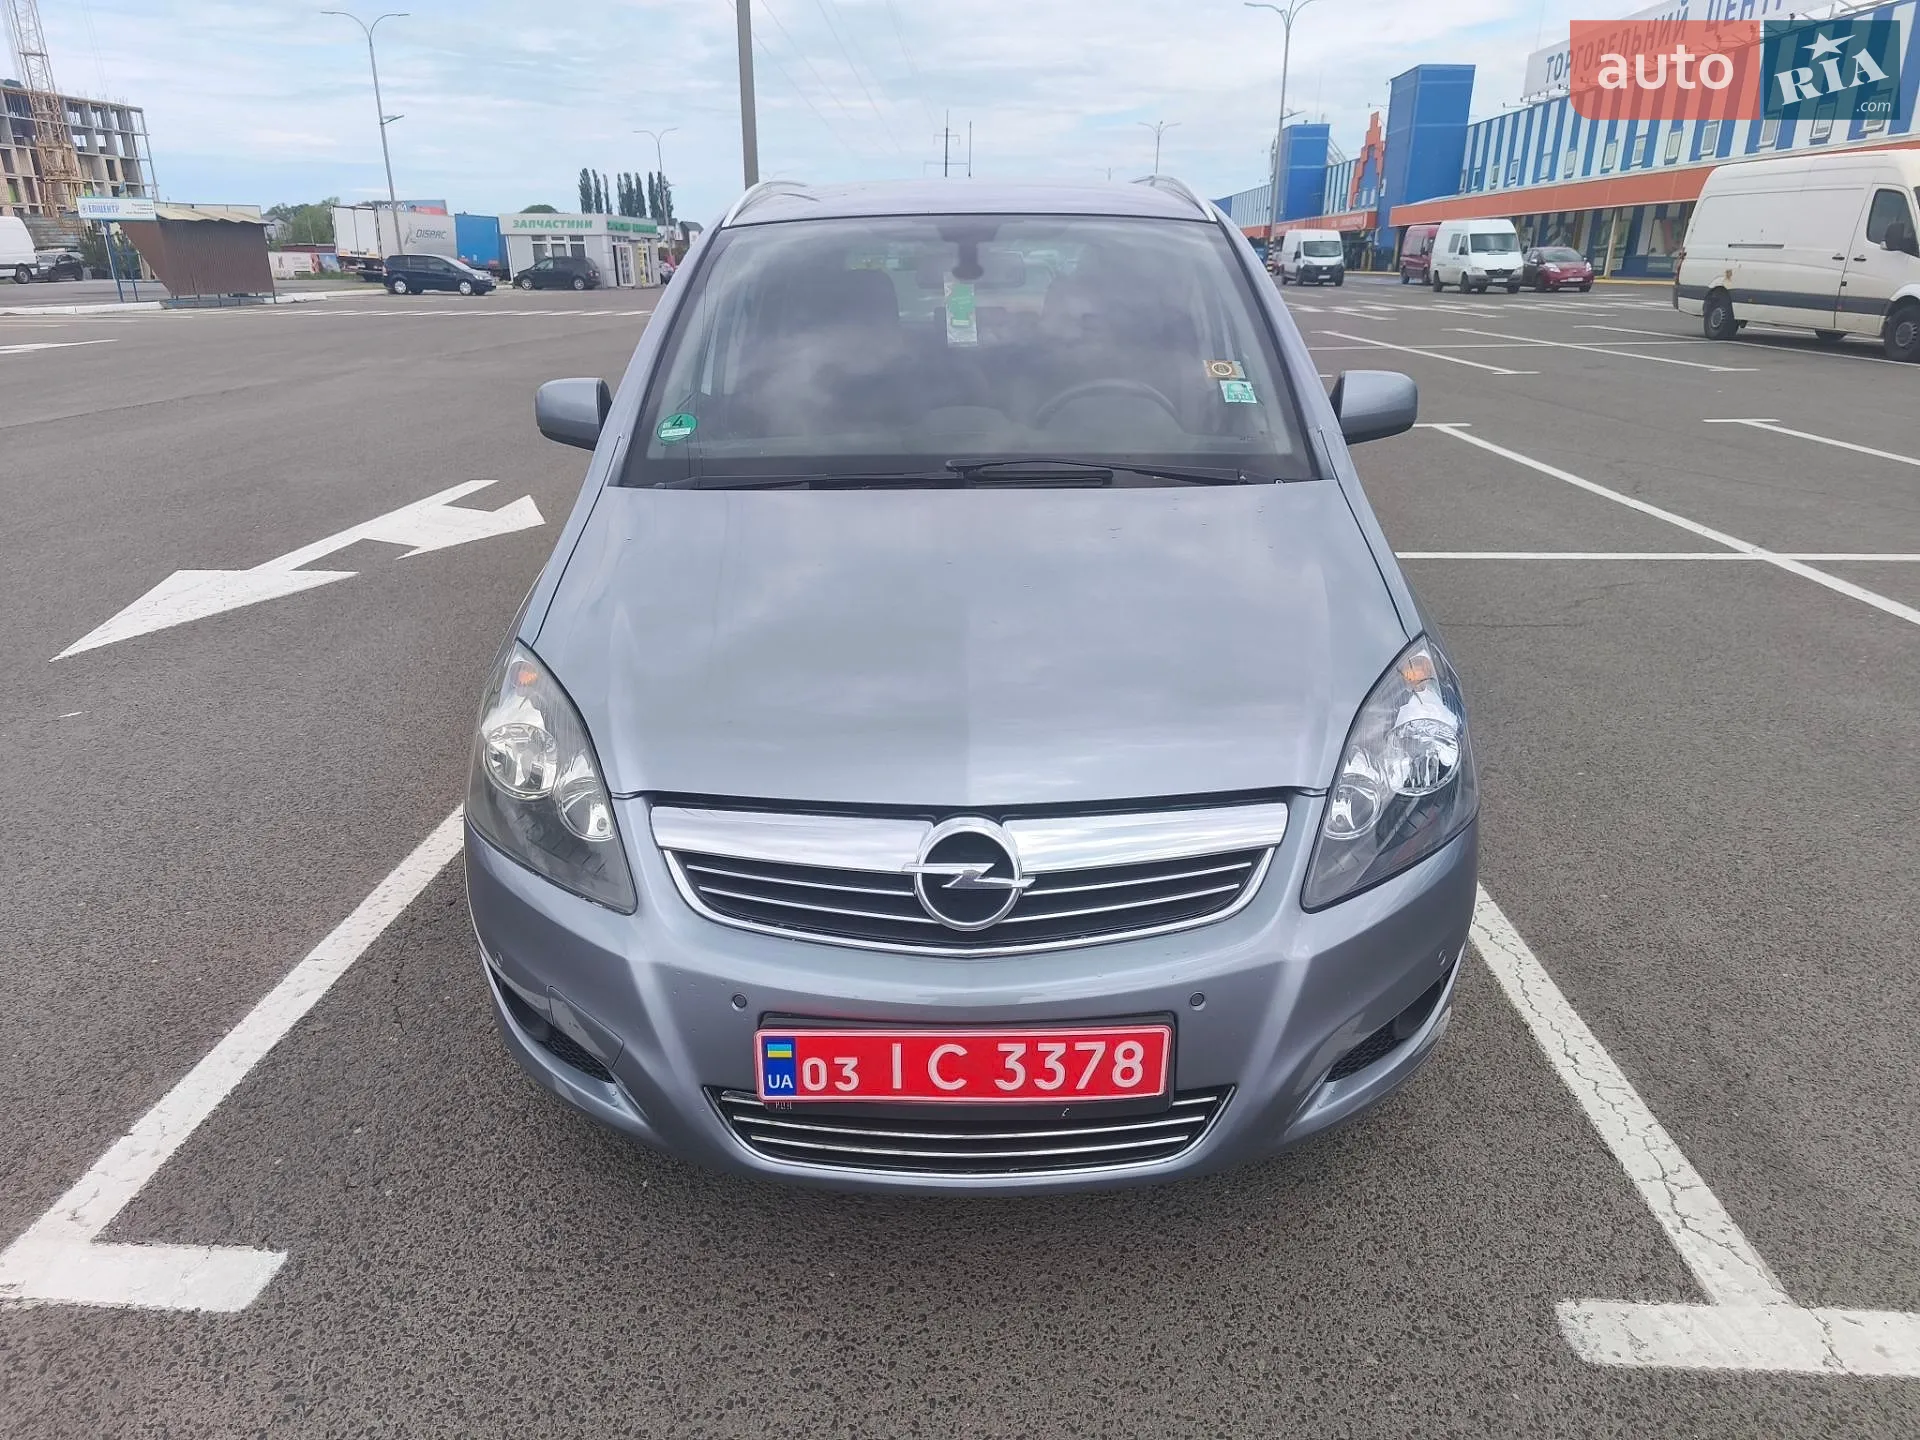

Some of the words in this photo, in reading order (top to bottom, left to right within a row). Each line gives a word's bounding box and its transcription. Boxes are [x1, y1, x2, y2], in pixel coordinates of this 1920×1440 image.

[512, 219, 593, 229] ЗАПЧАСТИНИ
[672, 415, 684, 427] 4
[802, 1057, 860, 1092] 03
[994, 1041, 1144, 1091] 3378
[768, 1074, 794, 1089] UA
